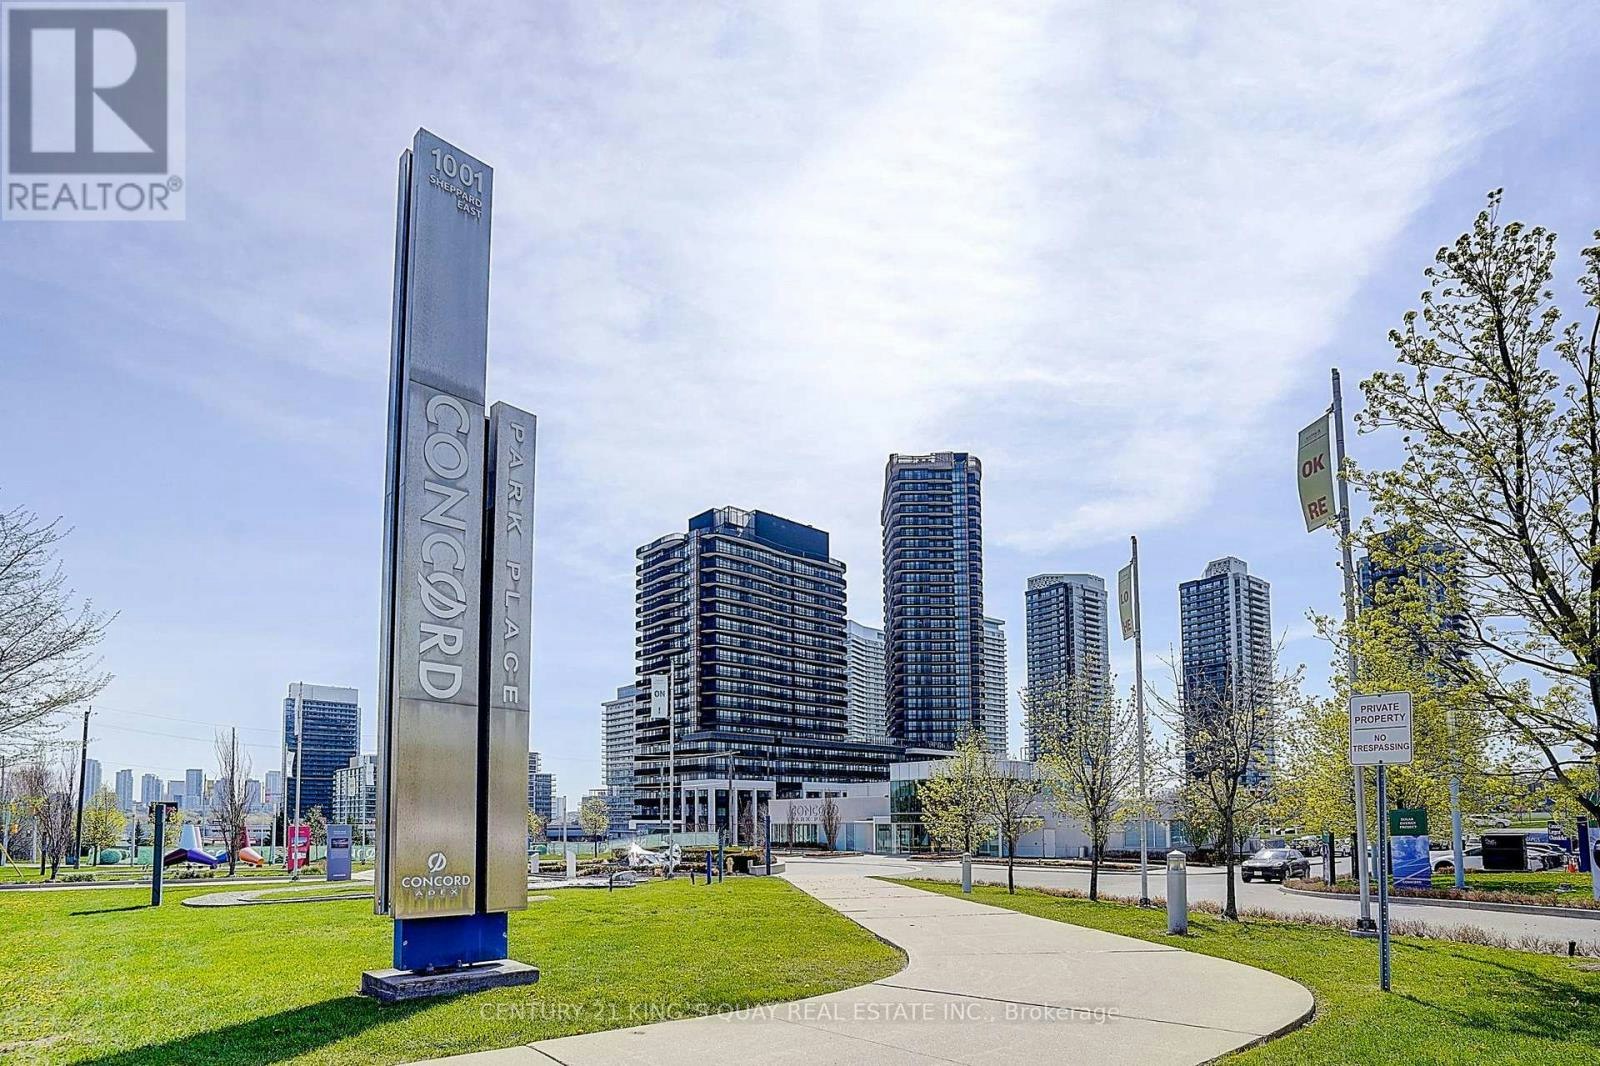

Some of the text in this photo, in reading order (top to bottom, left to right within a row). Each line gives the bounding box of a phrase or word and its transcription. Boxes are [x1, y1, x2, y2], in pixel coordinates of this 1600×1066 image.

[431, 148, 483, 194] 1001
[429, 174, 482, 208] SHEPPARD
[457, 200, 482, 218] EAST
[1302, 453, 1325, 479] OK
[1307, 496, 1328, 520] RE
[502, 421, 526, 705] PARK PLACE
[654, 690, 666, 698] ON
[1360, 702, 1400, 713] PRIVATE
[1354, 713, 1406, 724] PROPERTY
[1374, 734, 1387, 742] NO
[1352, 742, 1410, 752] TRESPASSING
[401, 875, 471, 888] CONCORD
